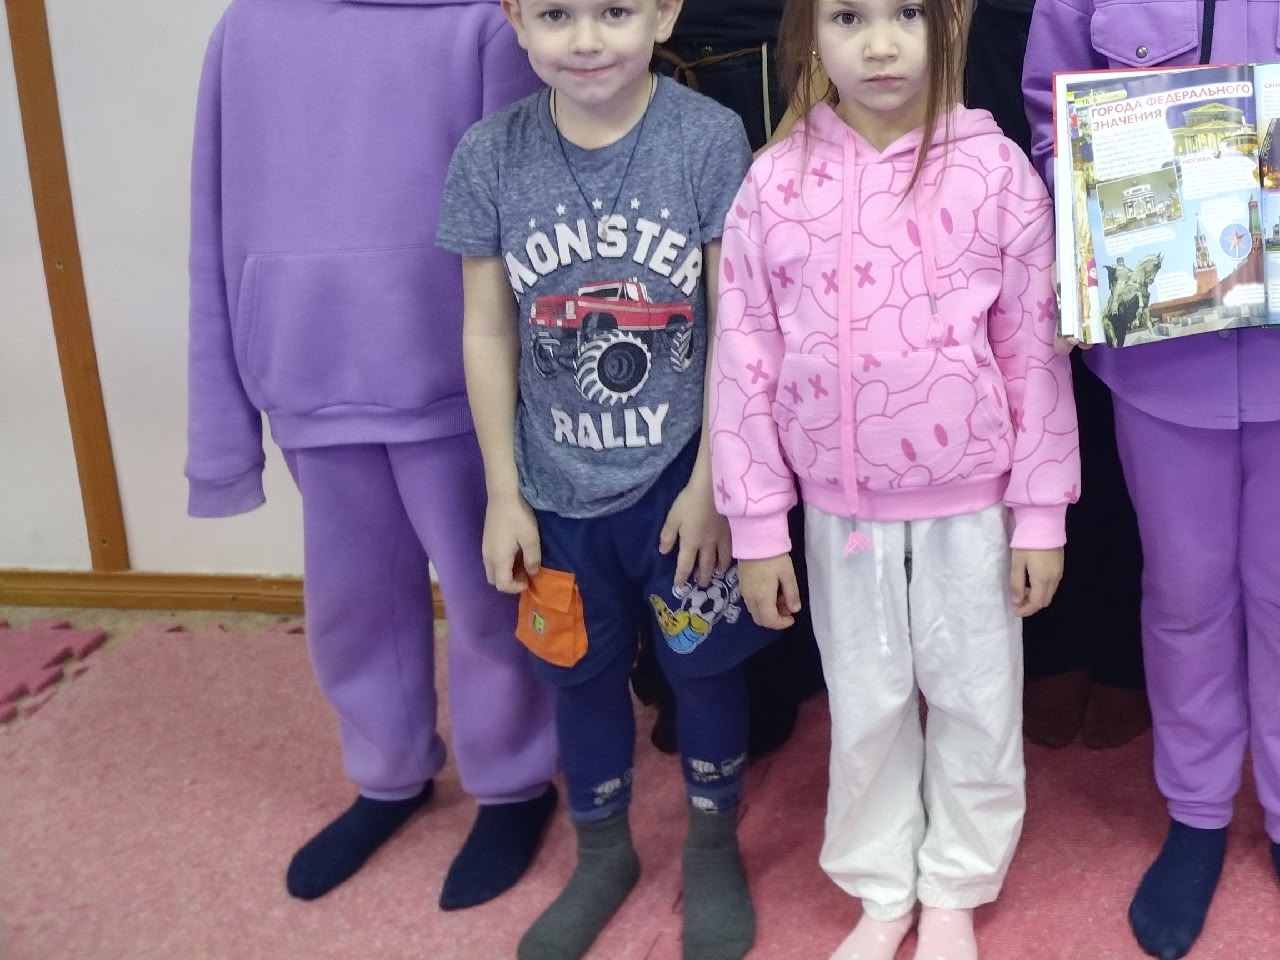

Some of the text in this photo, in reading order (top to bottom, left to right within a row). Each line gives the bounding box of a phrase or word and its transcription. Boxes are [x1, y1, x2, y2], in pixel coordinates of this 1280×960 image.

[1091, 101, 1143, 119] ГОРОДА
[1148, 84, 1250, 107] ФЕДЕРАЛЬНОГО
[1093, 109, 1163, 133] ЗНАЧЕНИЯ
[505, 214, 703, 304] MONSTER
[551, 400, 670, 451] RALLY
